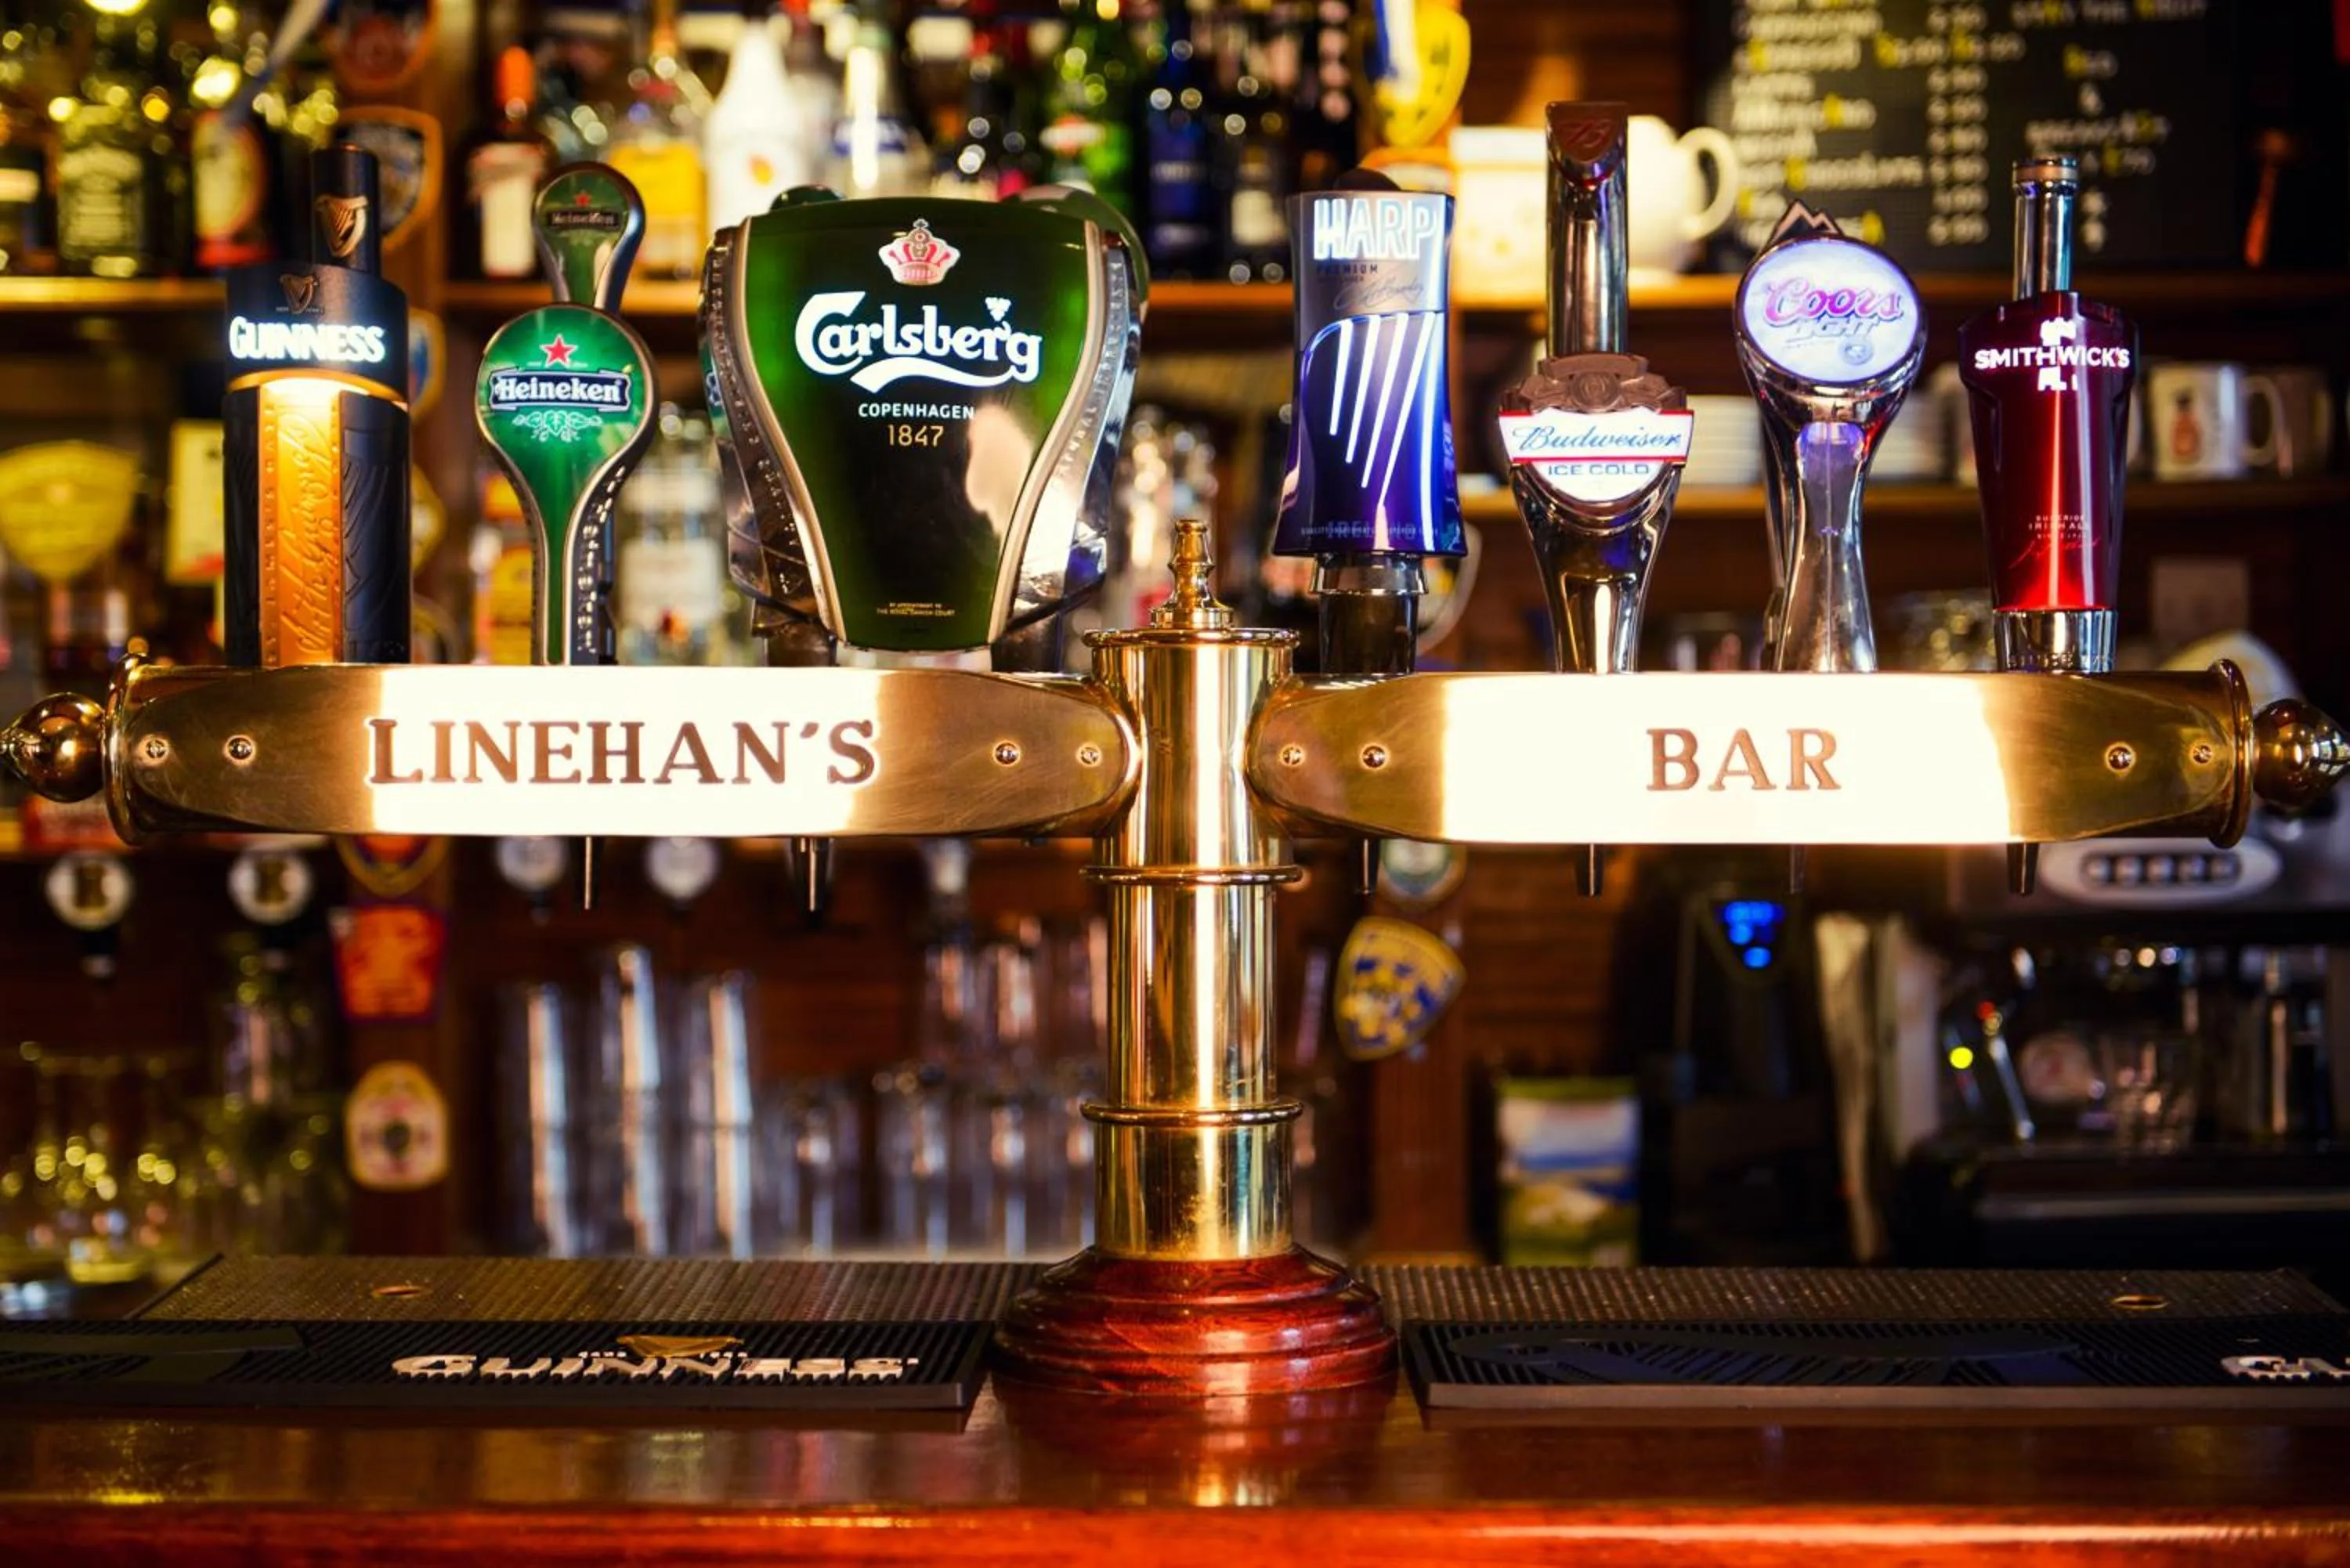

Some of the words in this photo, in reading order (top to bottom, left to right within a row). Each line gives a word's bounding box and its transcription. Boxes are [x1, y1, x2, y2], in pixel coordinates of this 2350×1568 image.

[1314, 198, 1436, 260] HARP
[1762, 276, 1904, 327] Coors
[229, 316, 385, 363] GUINNESS
[795, 291, 1043, 383] Carlsberg
[1974, 344, 2131, 370] SMITHWICK'S
[495, 376, 622, 403] Heineken
[858, 403, 976, 421] COPENHAGEN
[887, 424, 944, 447] 1847
[1513, 426, 1683, 451] Budweiser
[1548, 464, 1582, 476] ICE
[1589, 463, 1650, 475] COLD
[368, 718, 876, 784] LINEHAN'S
[1645, 728, 1842, 791] BAR
